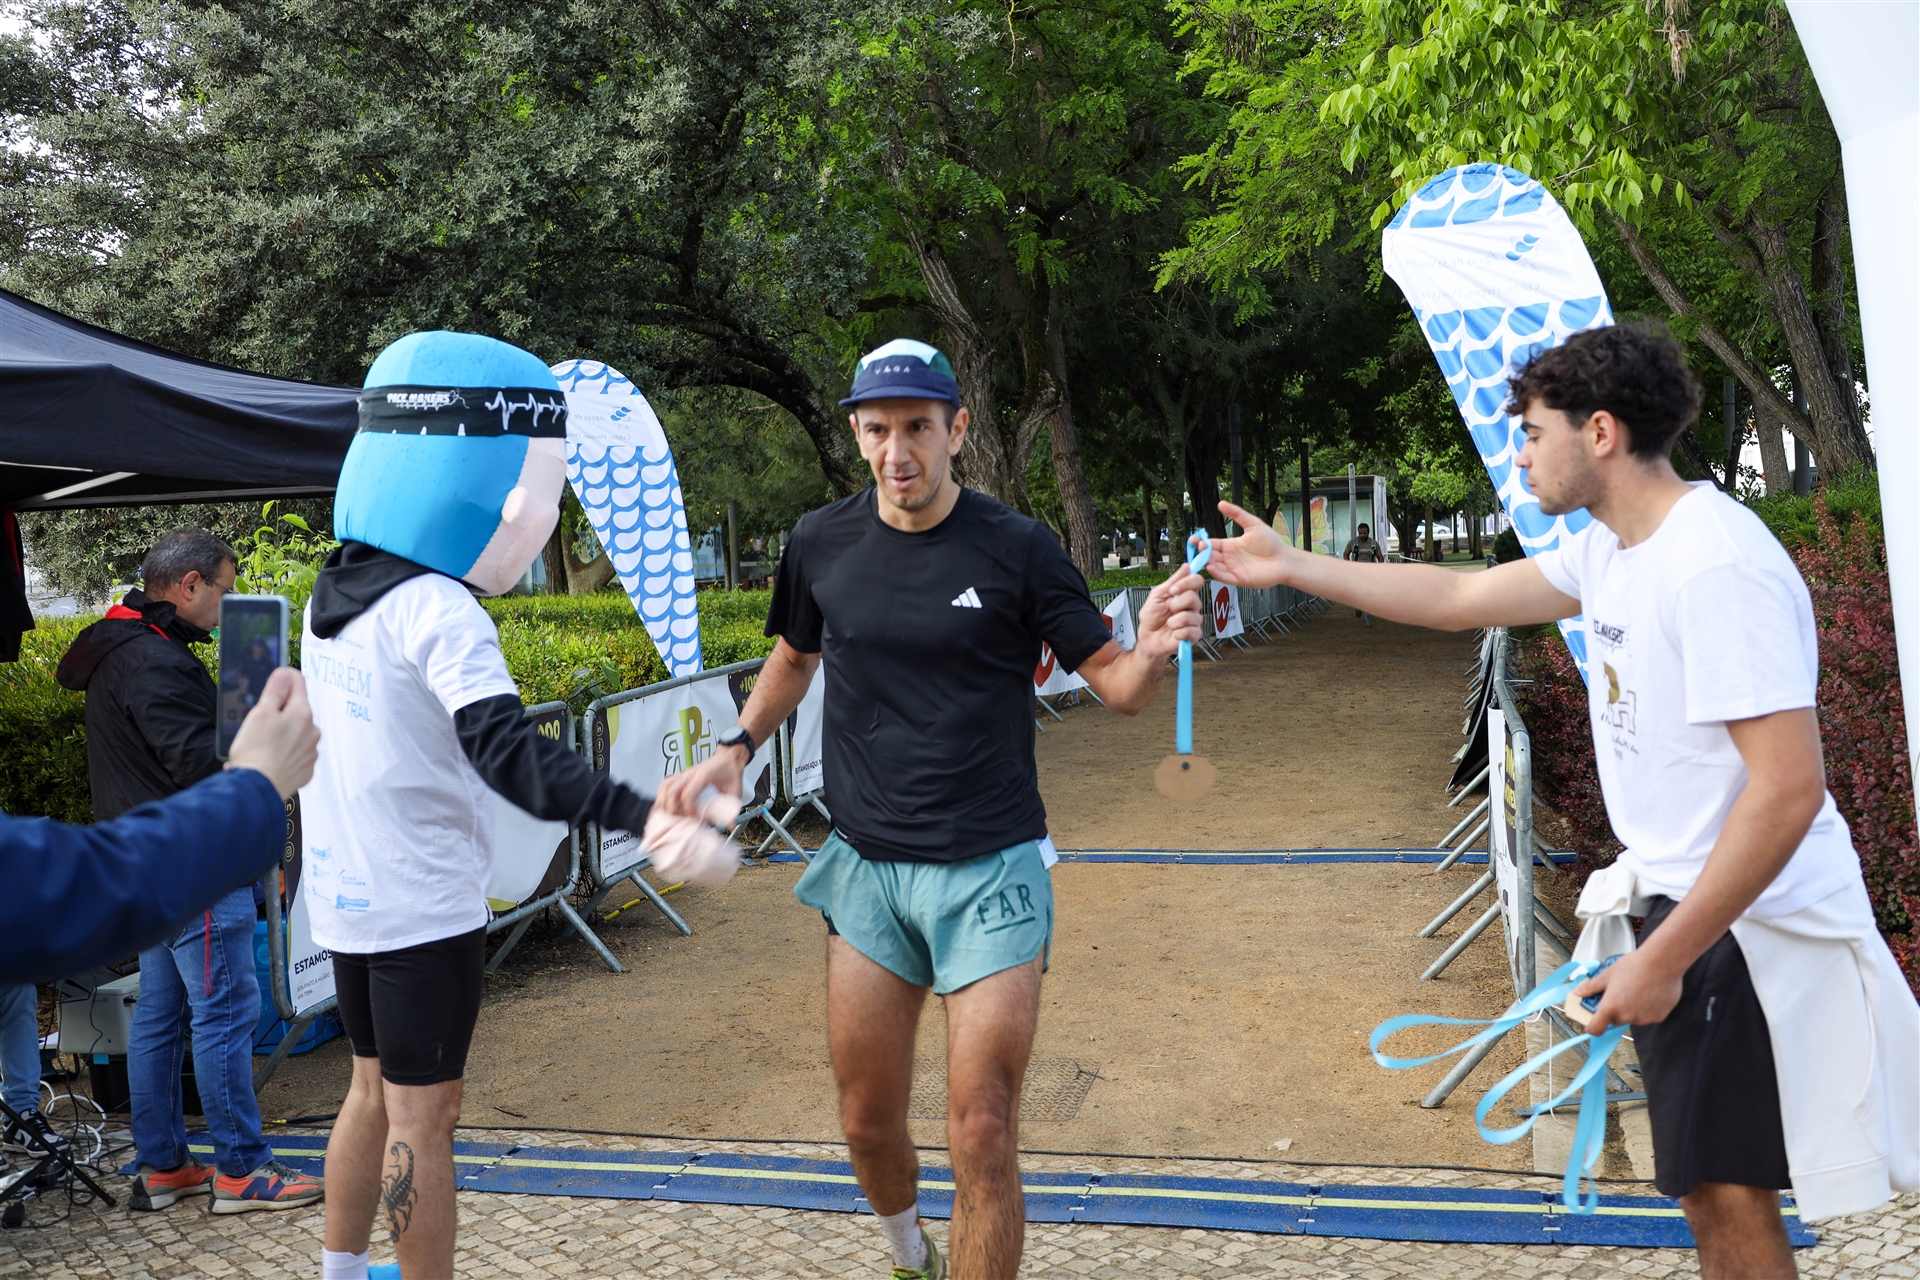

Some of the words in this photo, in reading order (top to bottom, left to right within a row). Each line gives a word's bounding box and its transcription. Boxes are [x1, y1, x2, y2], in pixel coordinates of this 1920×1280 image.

[409, 393, 450, 403] MAKERS
[346, 700, 372, 722] TRAIL
[603, 832, 630, 851] ESTAMOS
[977, 884, 1034, 925] FAR
[294, 949, 333, 975] ESTAMOS
